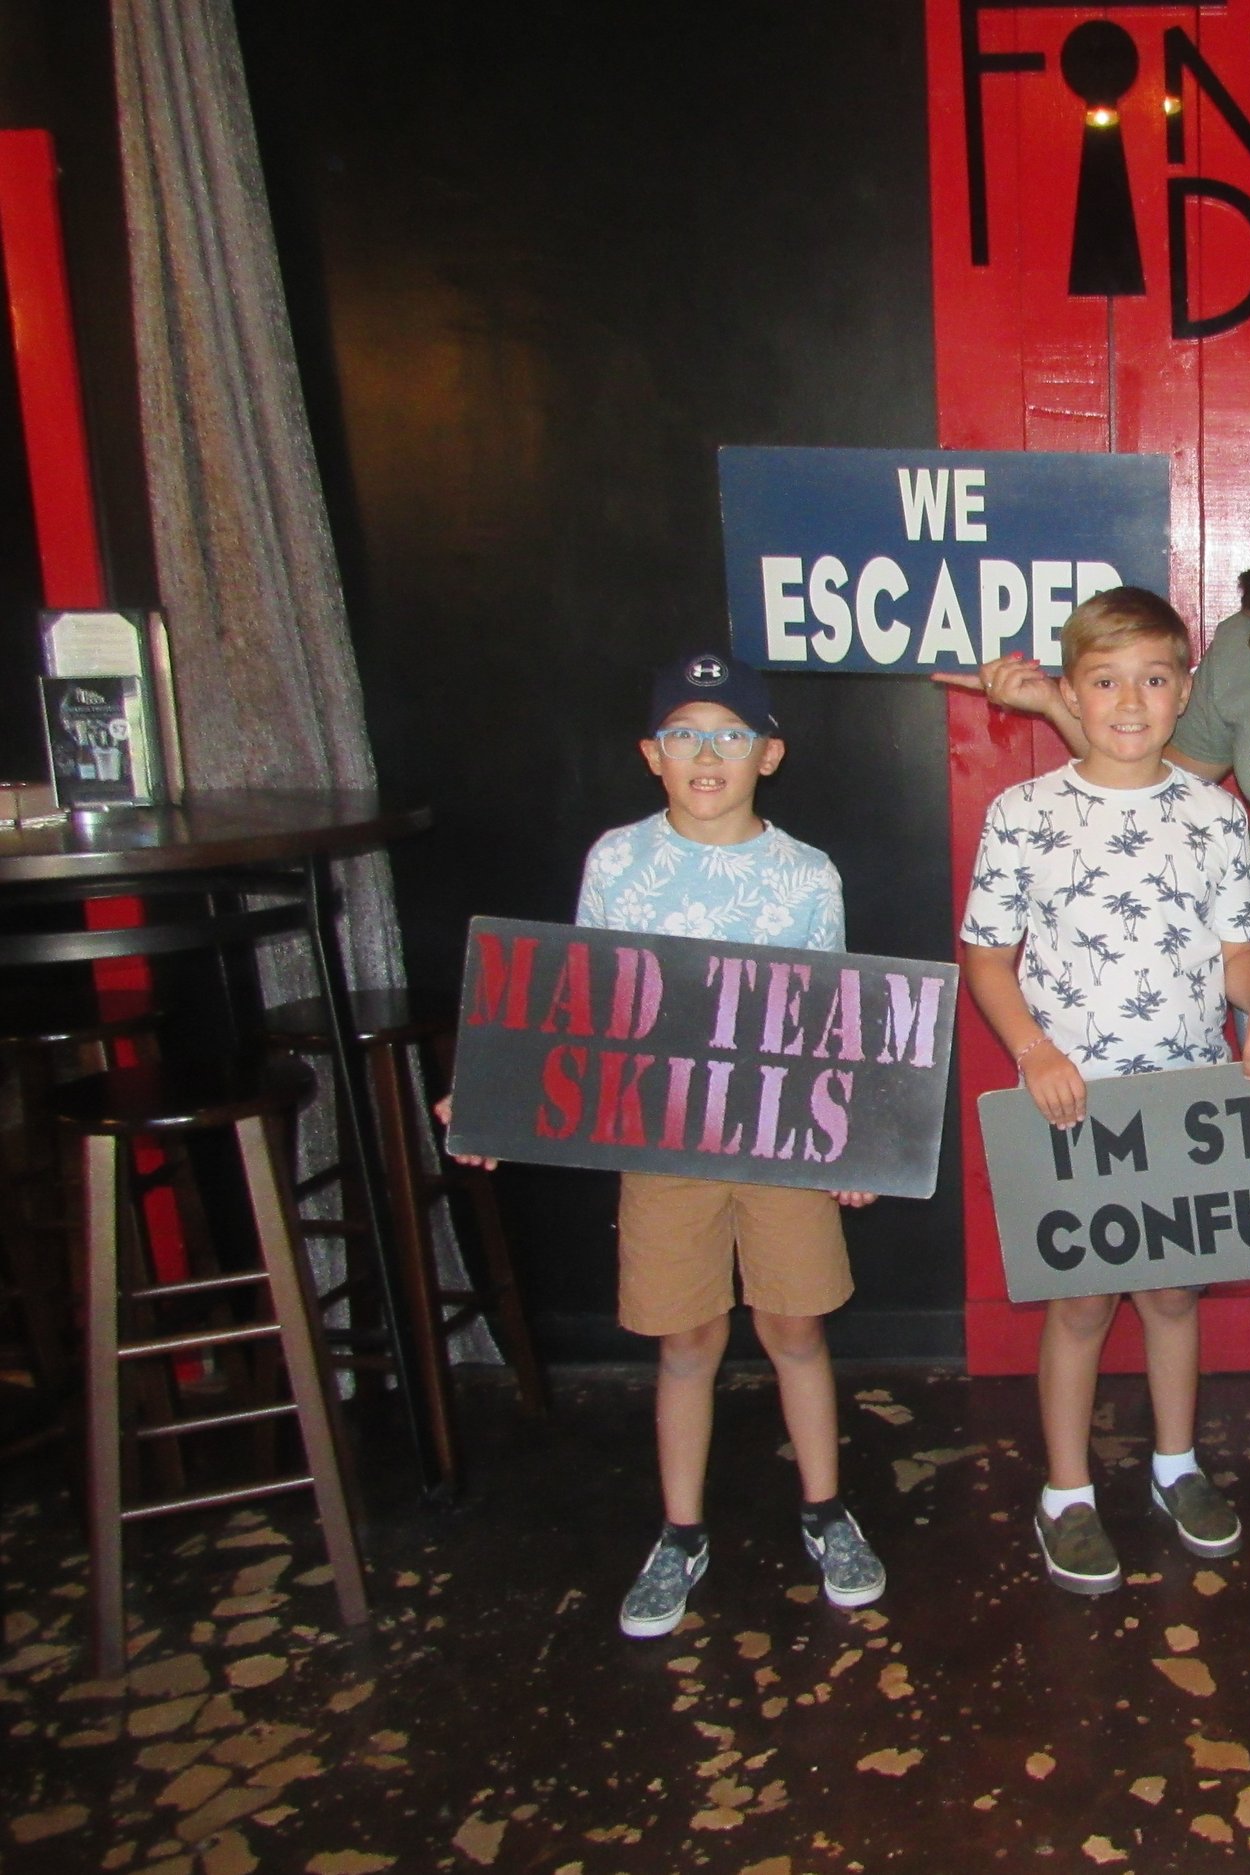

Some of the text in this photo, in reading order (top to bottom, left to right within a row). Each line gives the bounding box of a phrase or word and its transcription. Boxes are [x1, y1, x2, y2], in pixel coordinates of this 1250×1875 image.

[898, 468, 988, 542] WE
[466, 932, 945, 1069] MAD TEAM
[535, 1044, 855, 1164] SKILLS
[1048, 1108, 1150, 1181] I'M
